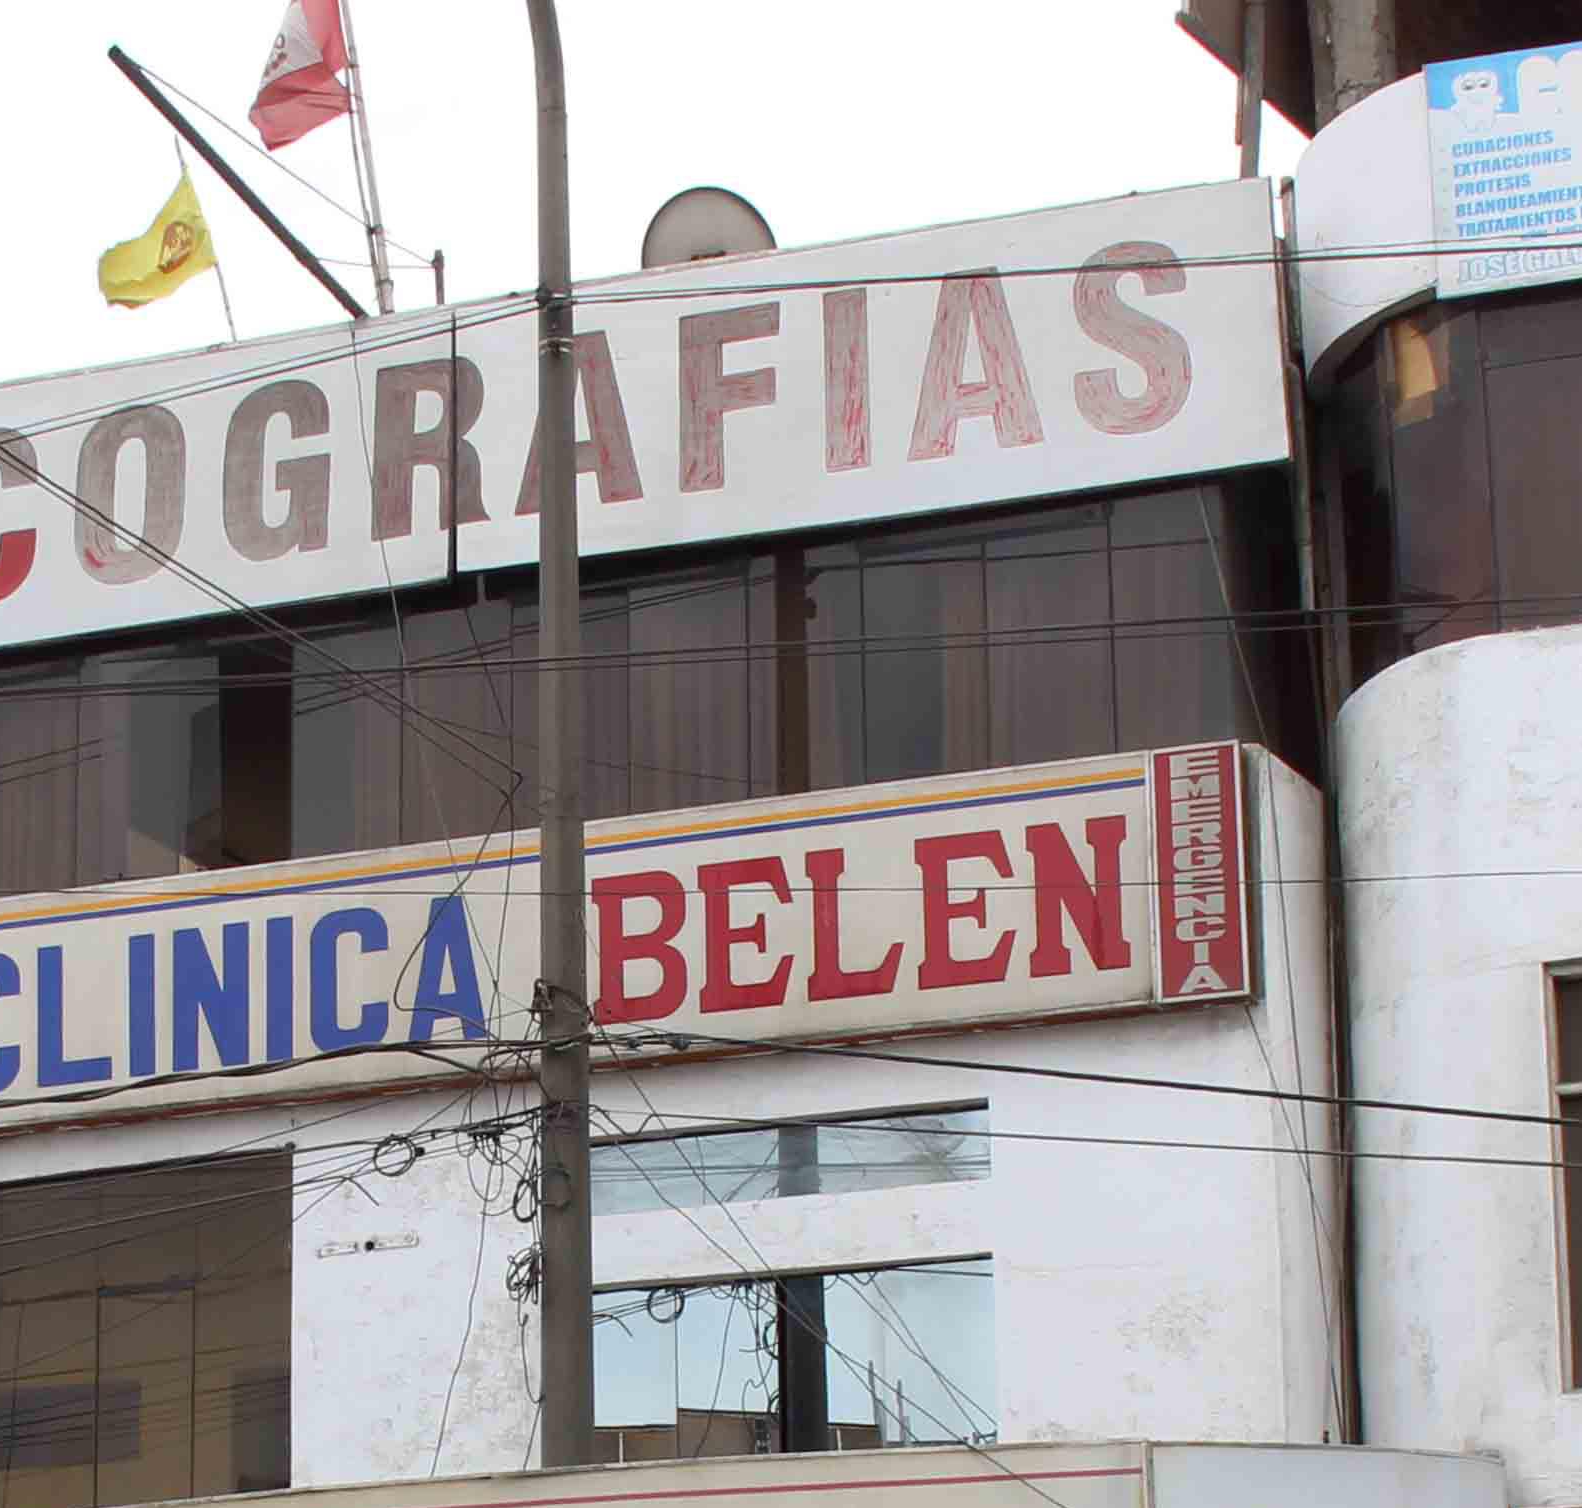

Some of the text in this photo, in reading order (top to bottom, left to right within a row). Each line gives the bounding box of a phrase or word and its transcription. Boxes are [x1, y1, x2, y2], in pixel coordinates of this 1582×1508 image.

[1453, 148, 1572, 177] EXTRACCIONES
[1458, 207, 1576, 237] TRATAMIENTOS
[589, 813, 1132, 1026] BELEN
[1169, 749, 1229, 995] EMERGENCIA
